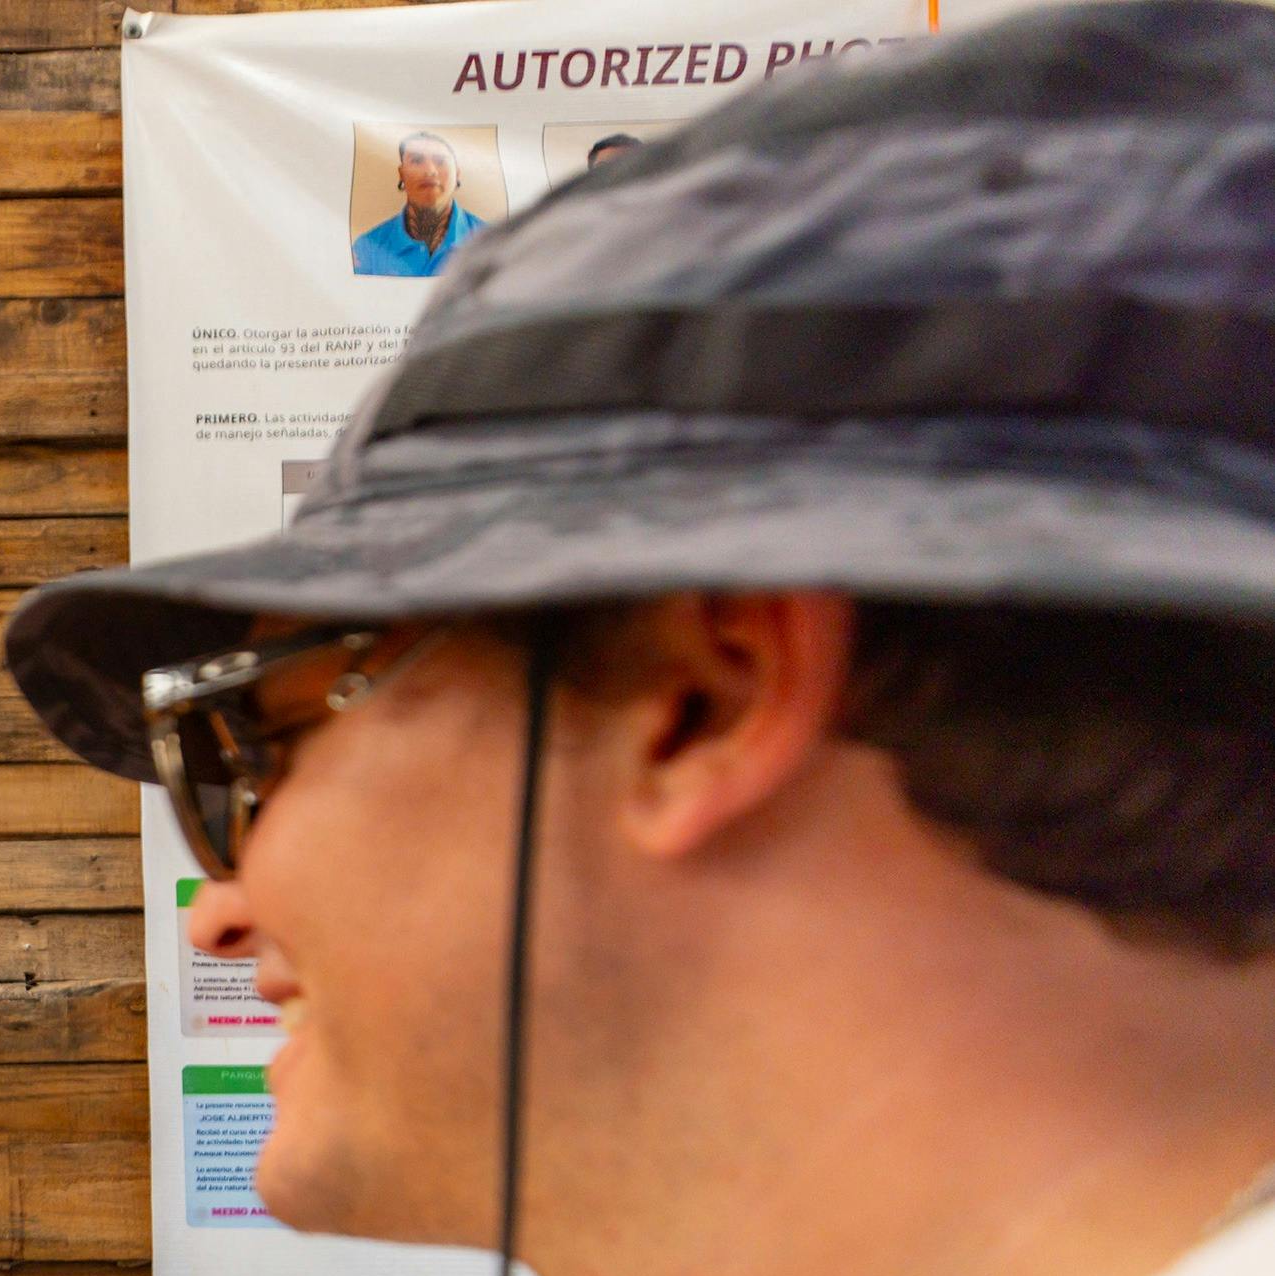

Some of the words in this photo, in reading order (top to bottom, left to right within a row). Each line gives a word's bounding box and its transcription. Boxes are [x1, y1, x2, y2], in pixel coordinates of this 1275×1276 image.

[452, 41, 749, 94] AUTORIZED
[243, 327, 293, 342] Otorgar
[296, 326, 308, 339] la
[311, 323, 391, 338] autorización
[192, 344, 208, 354] en
[212, 343, 225, 354] el
[280, 342, 296, 354] 93
[300, 341, 320, 353] del
[325, 339, 362, 352] RANP
[366, 341, 374, 352] y
[378, 337, 398, 350] del
[192, 359, 257, 372] quedando
[260, 359, 271, 370] la
[274, 358, 330, 372] presente
[264, 412, 286, 424] Las
[195, 429, 212, 440] de
[215, 430, 263, 442] manejo
